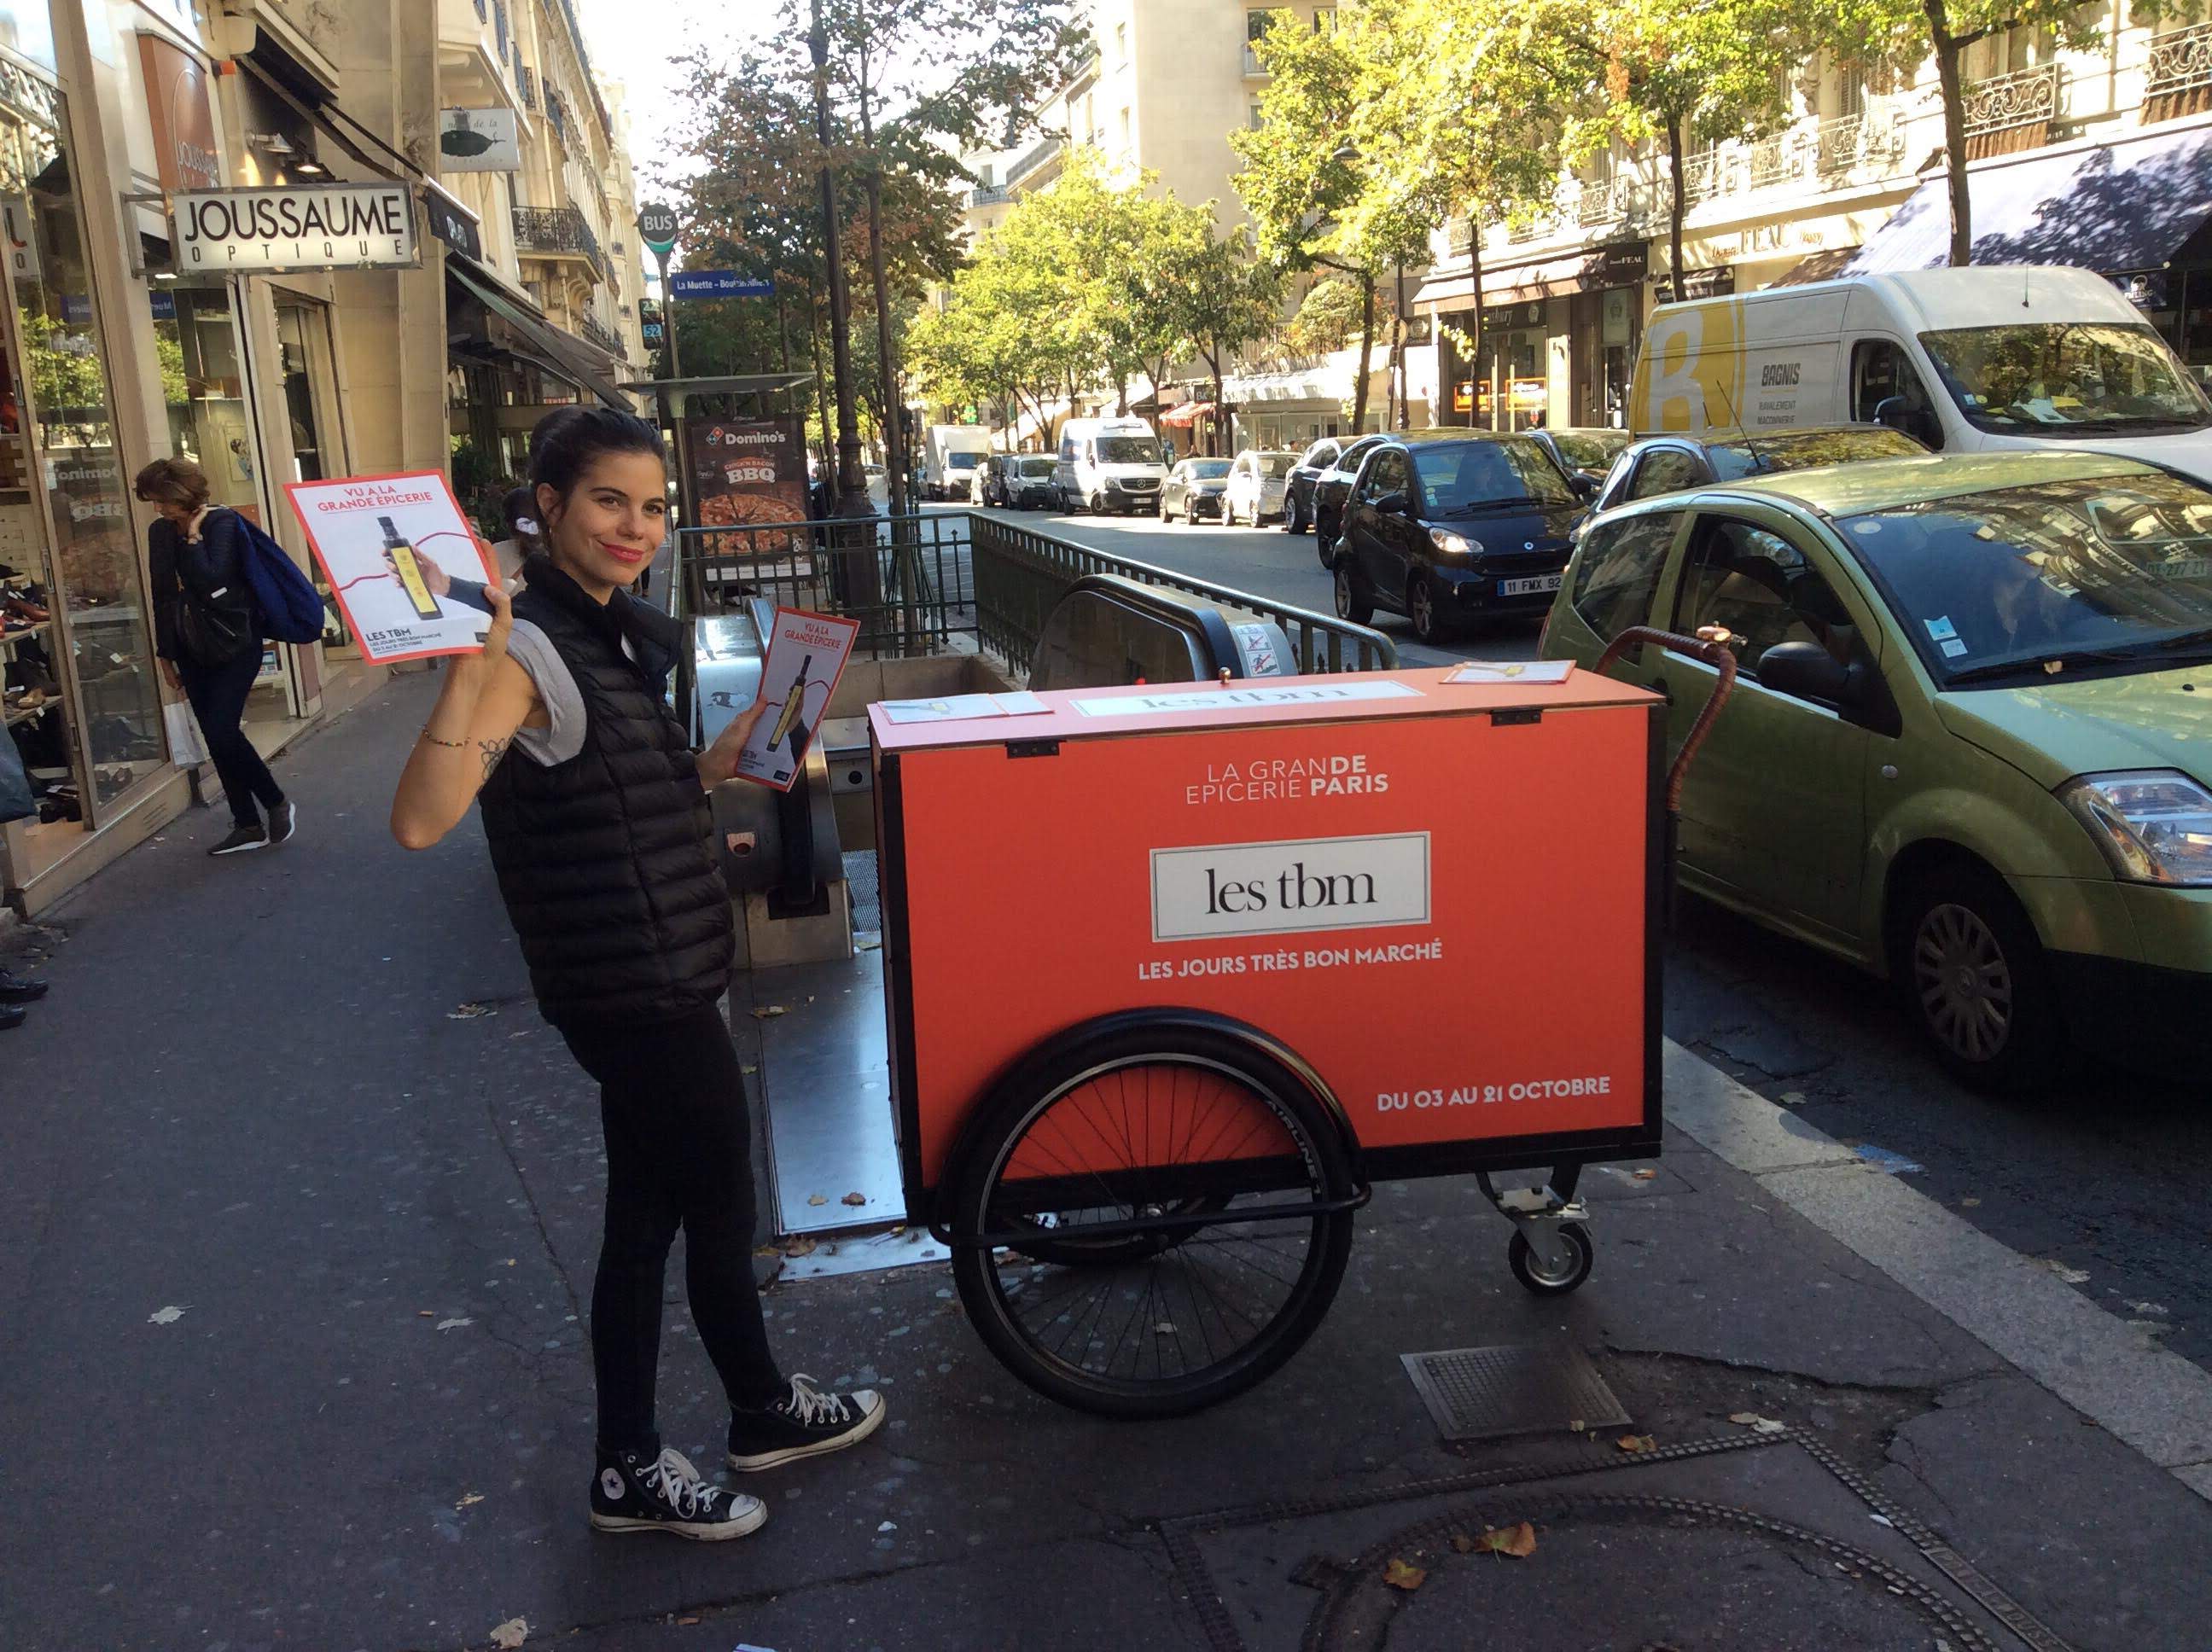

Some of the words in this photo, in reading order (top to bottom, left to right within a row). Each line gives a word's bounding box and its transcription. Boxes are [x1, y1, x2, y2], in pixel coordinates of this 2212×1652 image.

[185, 195, 403, 242] JOUSSAUME
[643, 215, 673, 231] BUS
[191, 240, 403, 263] OPTIQUE
[677, 281, 686, 290] La
[687, 280, 713, 289] Muette
[645, 325, 659, 335] 52
[1761, 363, 1802, 387] BAGNIS
[725, 430, 787, 445] Domino's
[725, 468, 777, 485] BBQ
[344, 487, 364, 497] VU
[379, 485, 397, 495] LA
[317, 499, 375, 512] GRANDE
[1508, 582, 1516, 592] 11
[1522, 579, 1543, 591] FMX
[1548, 577, 1562, 588] 92
[366, 631, 386, 642] LES
[387, 628, 411, 637] TBM
[785, 629, 814, 644] GRANDE
[1208, 763, 1240, 782] LA
[1249, 754, 1366, 781] GRANDE
[1186, 779, 1302, 805] EPICERIE
[1311, 773, 1389, 796] PARIS
[1204, 868, 1267, 915] les
[1277, 862, 1379, 910] tbm
[1139, 961, 1173, 981] LES
[1178, 955, 1246, 978] JOURS
[1250, 948, 1298, 972] TRÈS
[1305, 948, 1350, 969] BON
[1355, 938, 1443, 964] MARCHÉ
[1377, 1092, 1408, 1111] DU
[1413, 1090, 1443, 1108] 03
[1448, 1086, 1478, 1106] AU
[1483, 1085, 1503, 1102] 21
[1508, 1076, 1611, 1101] OCTOBRE
